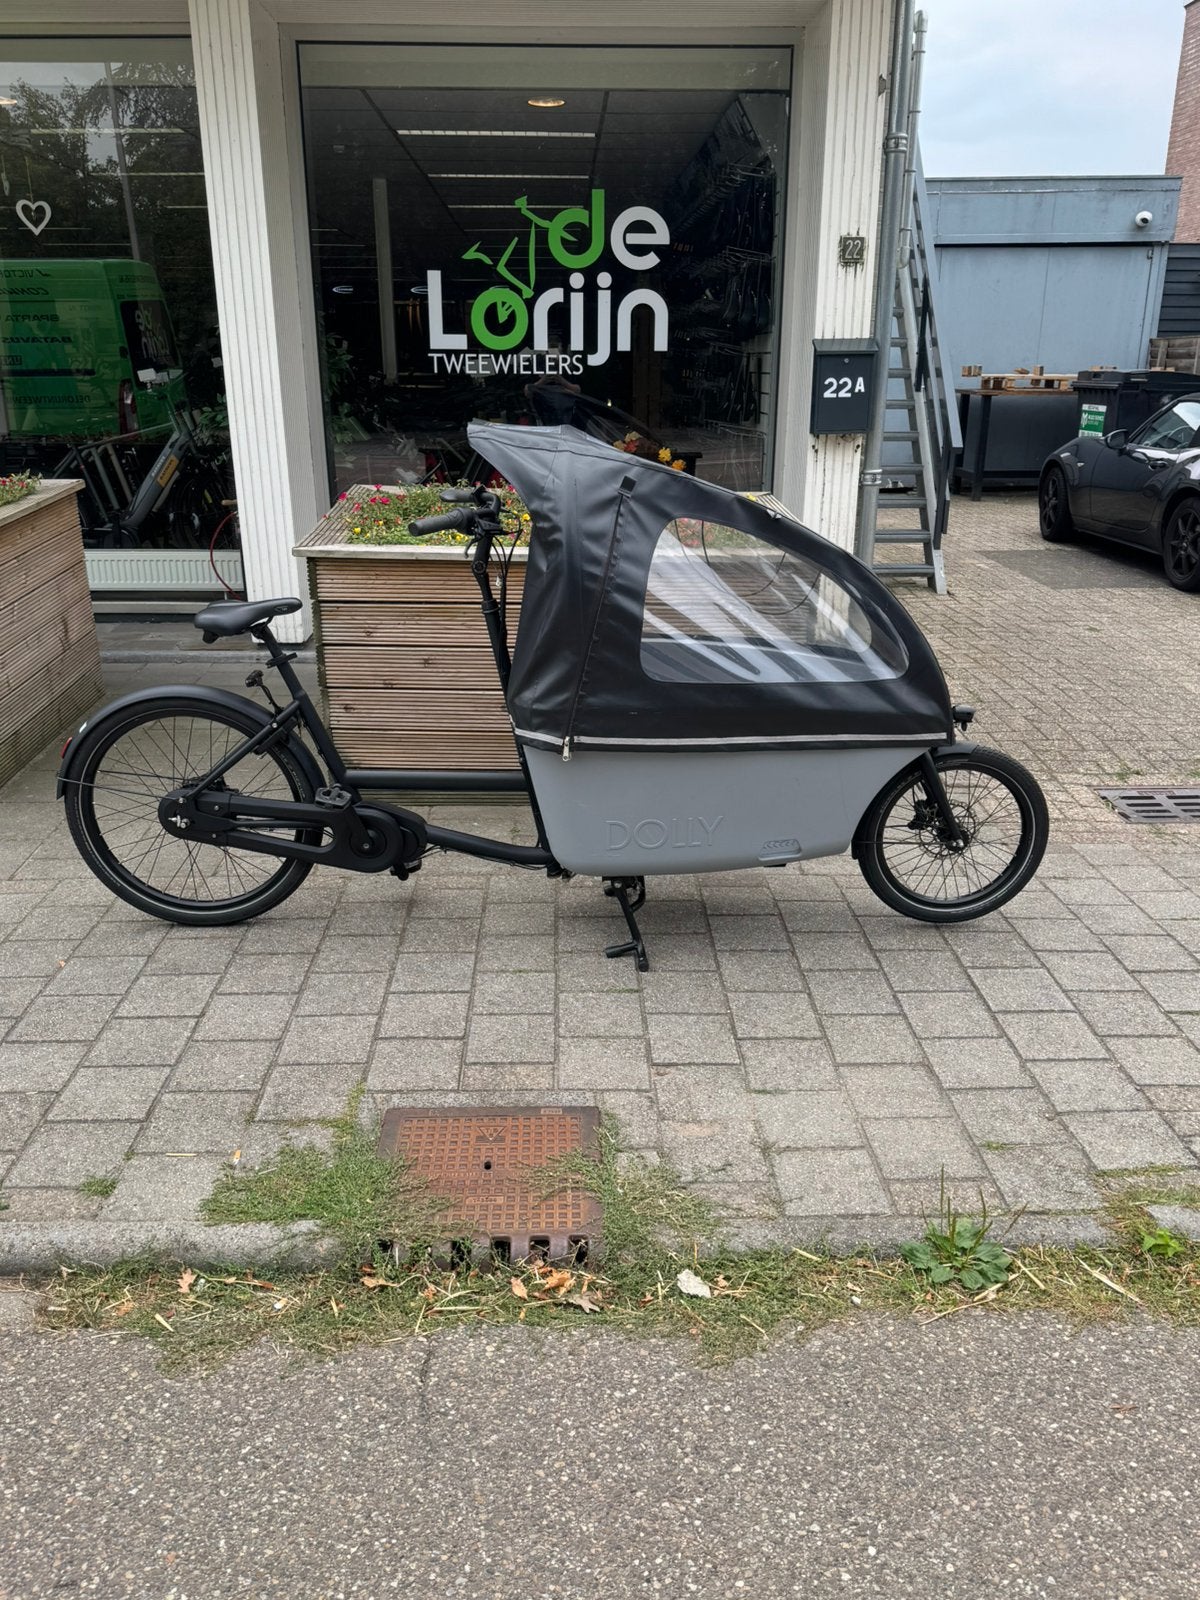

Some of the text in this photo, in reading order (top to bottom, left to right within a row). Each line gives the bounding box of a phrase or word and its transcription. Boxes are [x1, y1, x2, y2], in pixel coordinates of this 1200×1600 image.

[547, 188, 671, 271] de
[844, 239, 861, 259] 22
[426, 269, 669, 367] Lorijn
[427, 353, 584, 375] TWEEWIELERS
[823, 376, 865, 399] 22A
[604, 815, 725, 852] DOLLY
